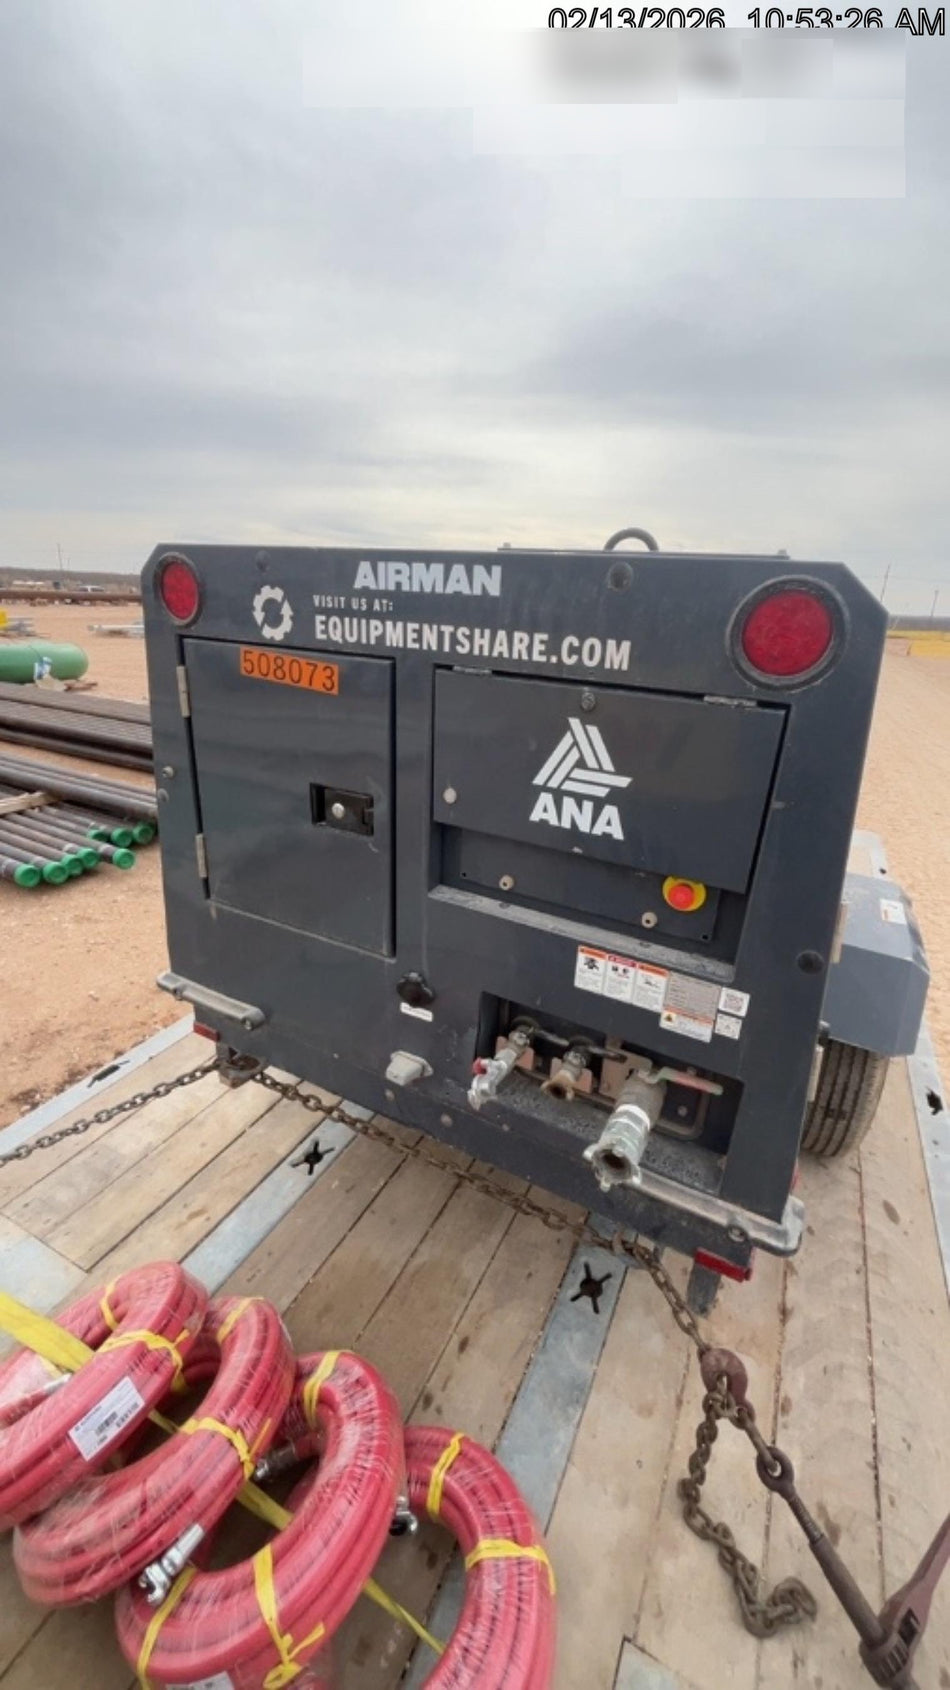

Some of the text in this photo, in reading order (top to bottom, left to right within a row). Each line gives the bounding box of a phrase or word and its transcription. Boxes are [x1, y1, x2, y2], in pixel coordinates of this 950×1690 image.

[353, 561, 502, 597] AIRMAN
[312, 594, 394, 613] VISIT US AT:
[314, 614, 632, 672] EQUIPMENTSHARE.COM
[243, 650, 335, 692] 508073
[529, 792, 624, 841] ANA
